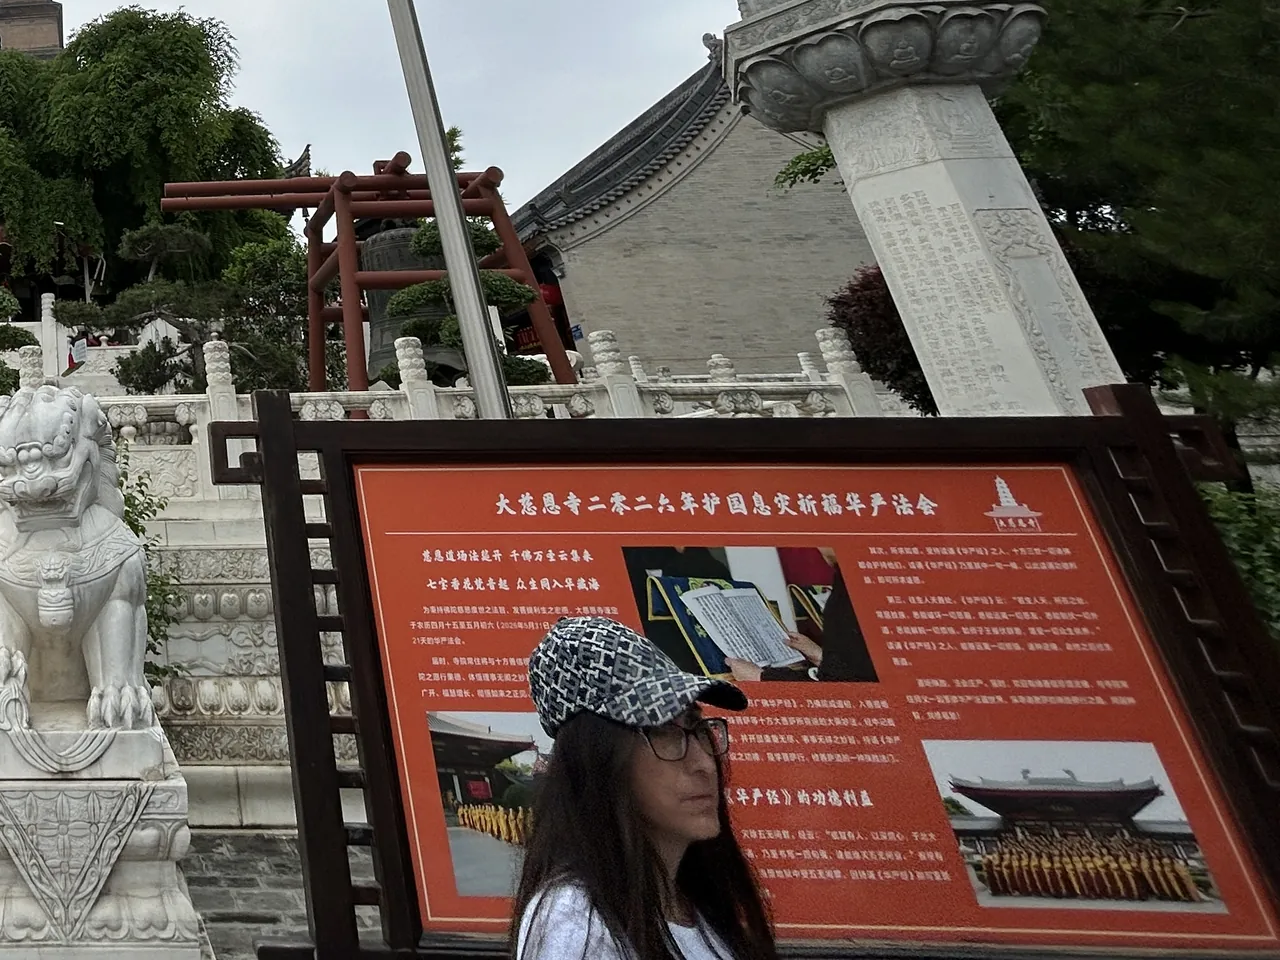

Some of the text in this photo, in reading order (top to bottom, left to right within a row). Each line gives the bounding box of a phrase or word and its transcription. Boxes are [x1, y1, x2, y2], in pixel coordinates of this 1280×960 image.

[495, 491, 938, 517] 大慈恩寺二零二六年护国息灾祈福华严法会
